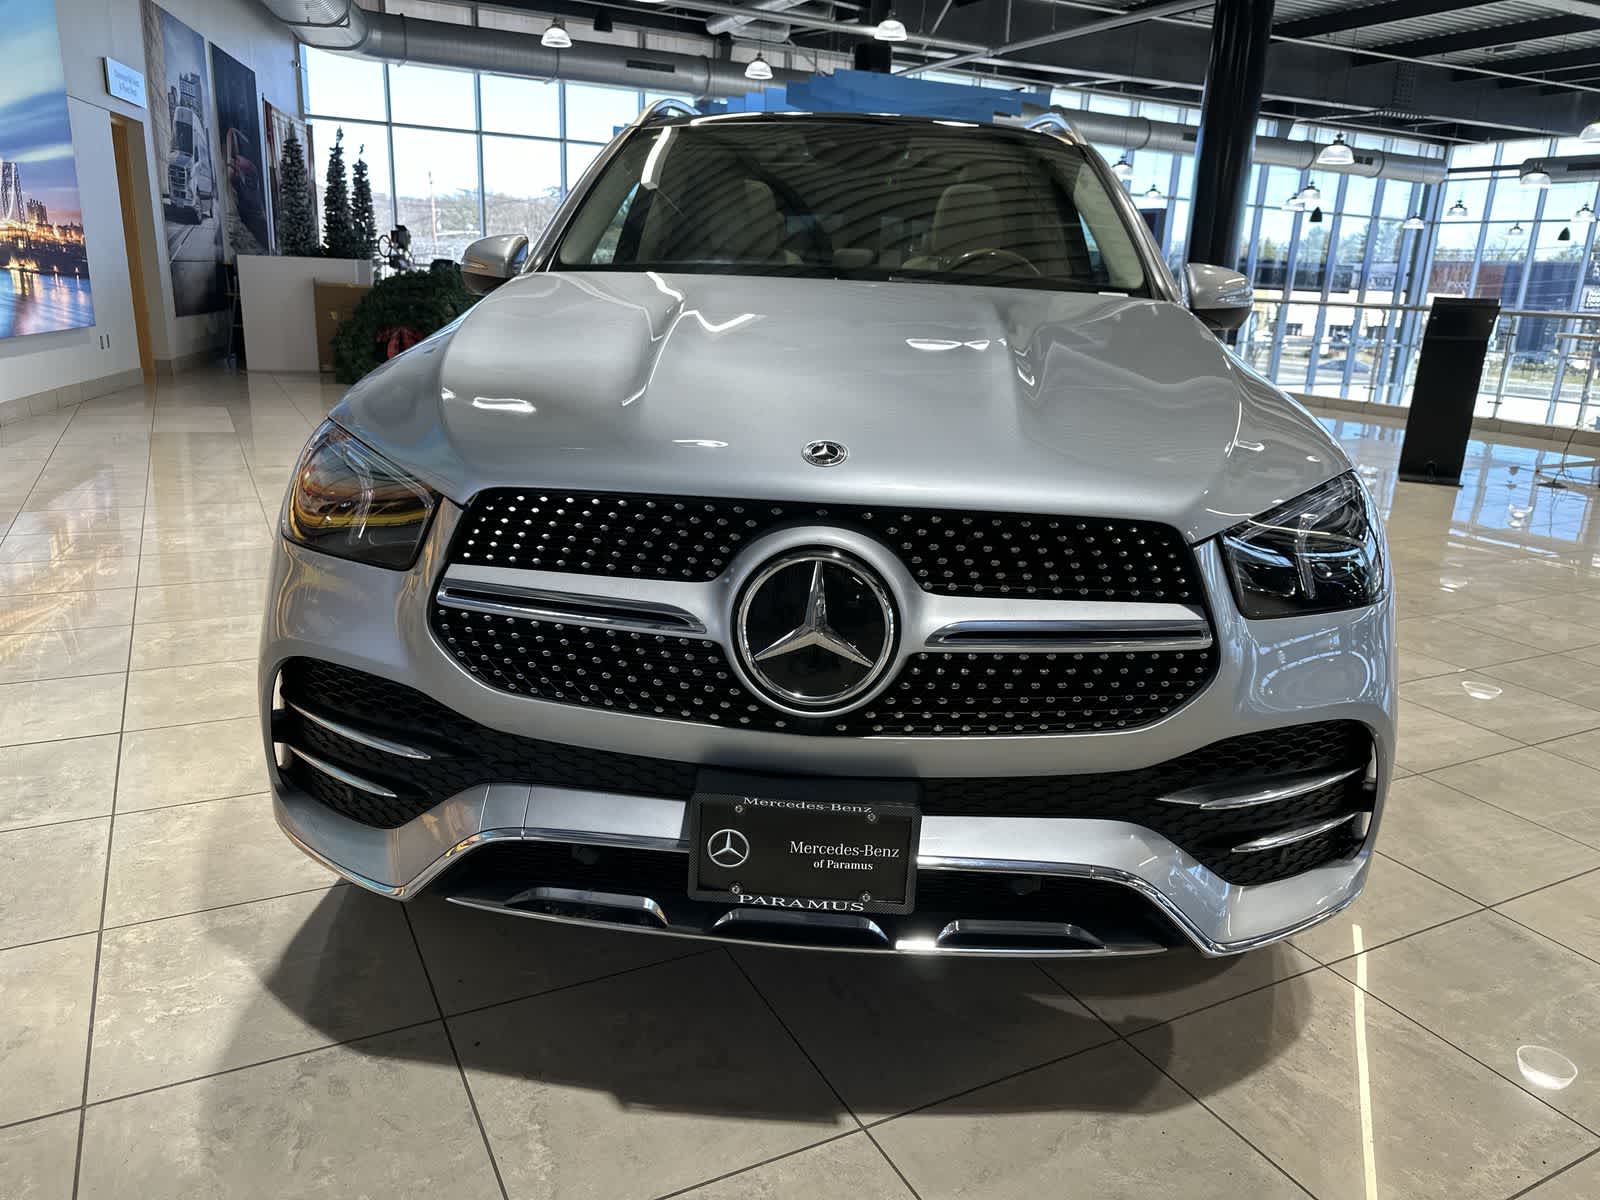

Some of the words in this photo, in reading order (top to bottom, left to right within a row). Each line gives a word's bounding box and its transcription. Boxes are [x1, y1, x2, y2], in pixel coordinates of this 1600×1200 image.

[743, 797, 873, 813] Mercedes-Benz
[790, 841, 900, 858] Mercedes-Benz
[813, 860, 824, 869] of
[826, 860, 874, 870] Paramus
[738, 894, 865, 912] PARAMUS
